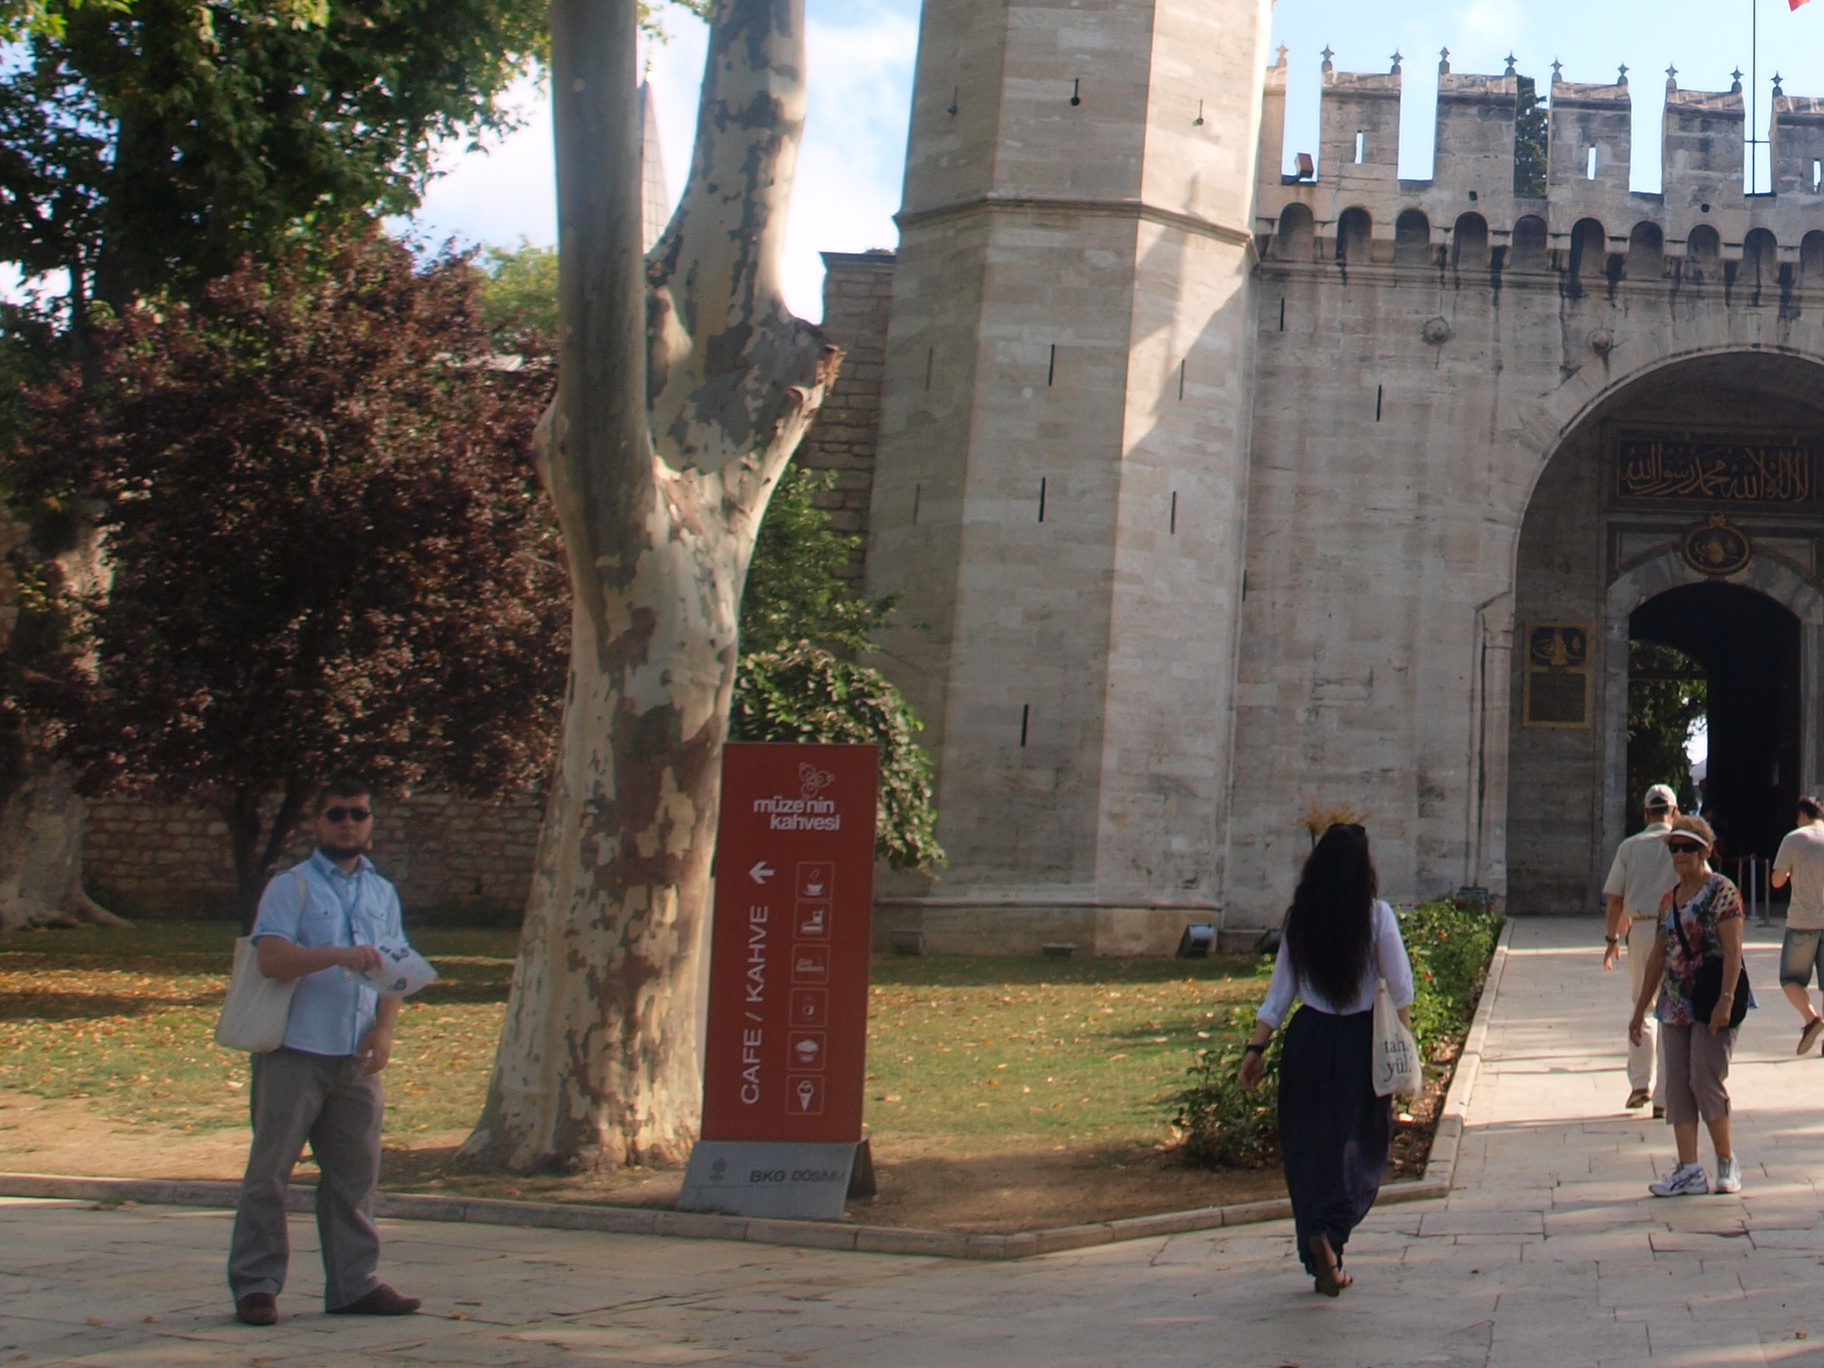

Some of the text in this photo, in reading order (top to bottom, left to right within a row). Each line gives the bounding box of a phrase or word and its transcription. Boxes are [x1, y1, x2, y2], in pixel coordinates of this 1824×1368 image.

[770, 813, 841, 831] kahvesi
[746, 905, 769, 1003] KAHVE
[740, 1029, 763, 1105] CAFE
[749, 1169, 786, 1183] BKG
